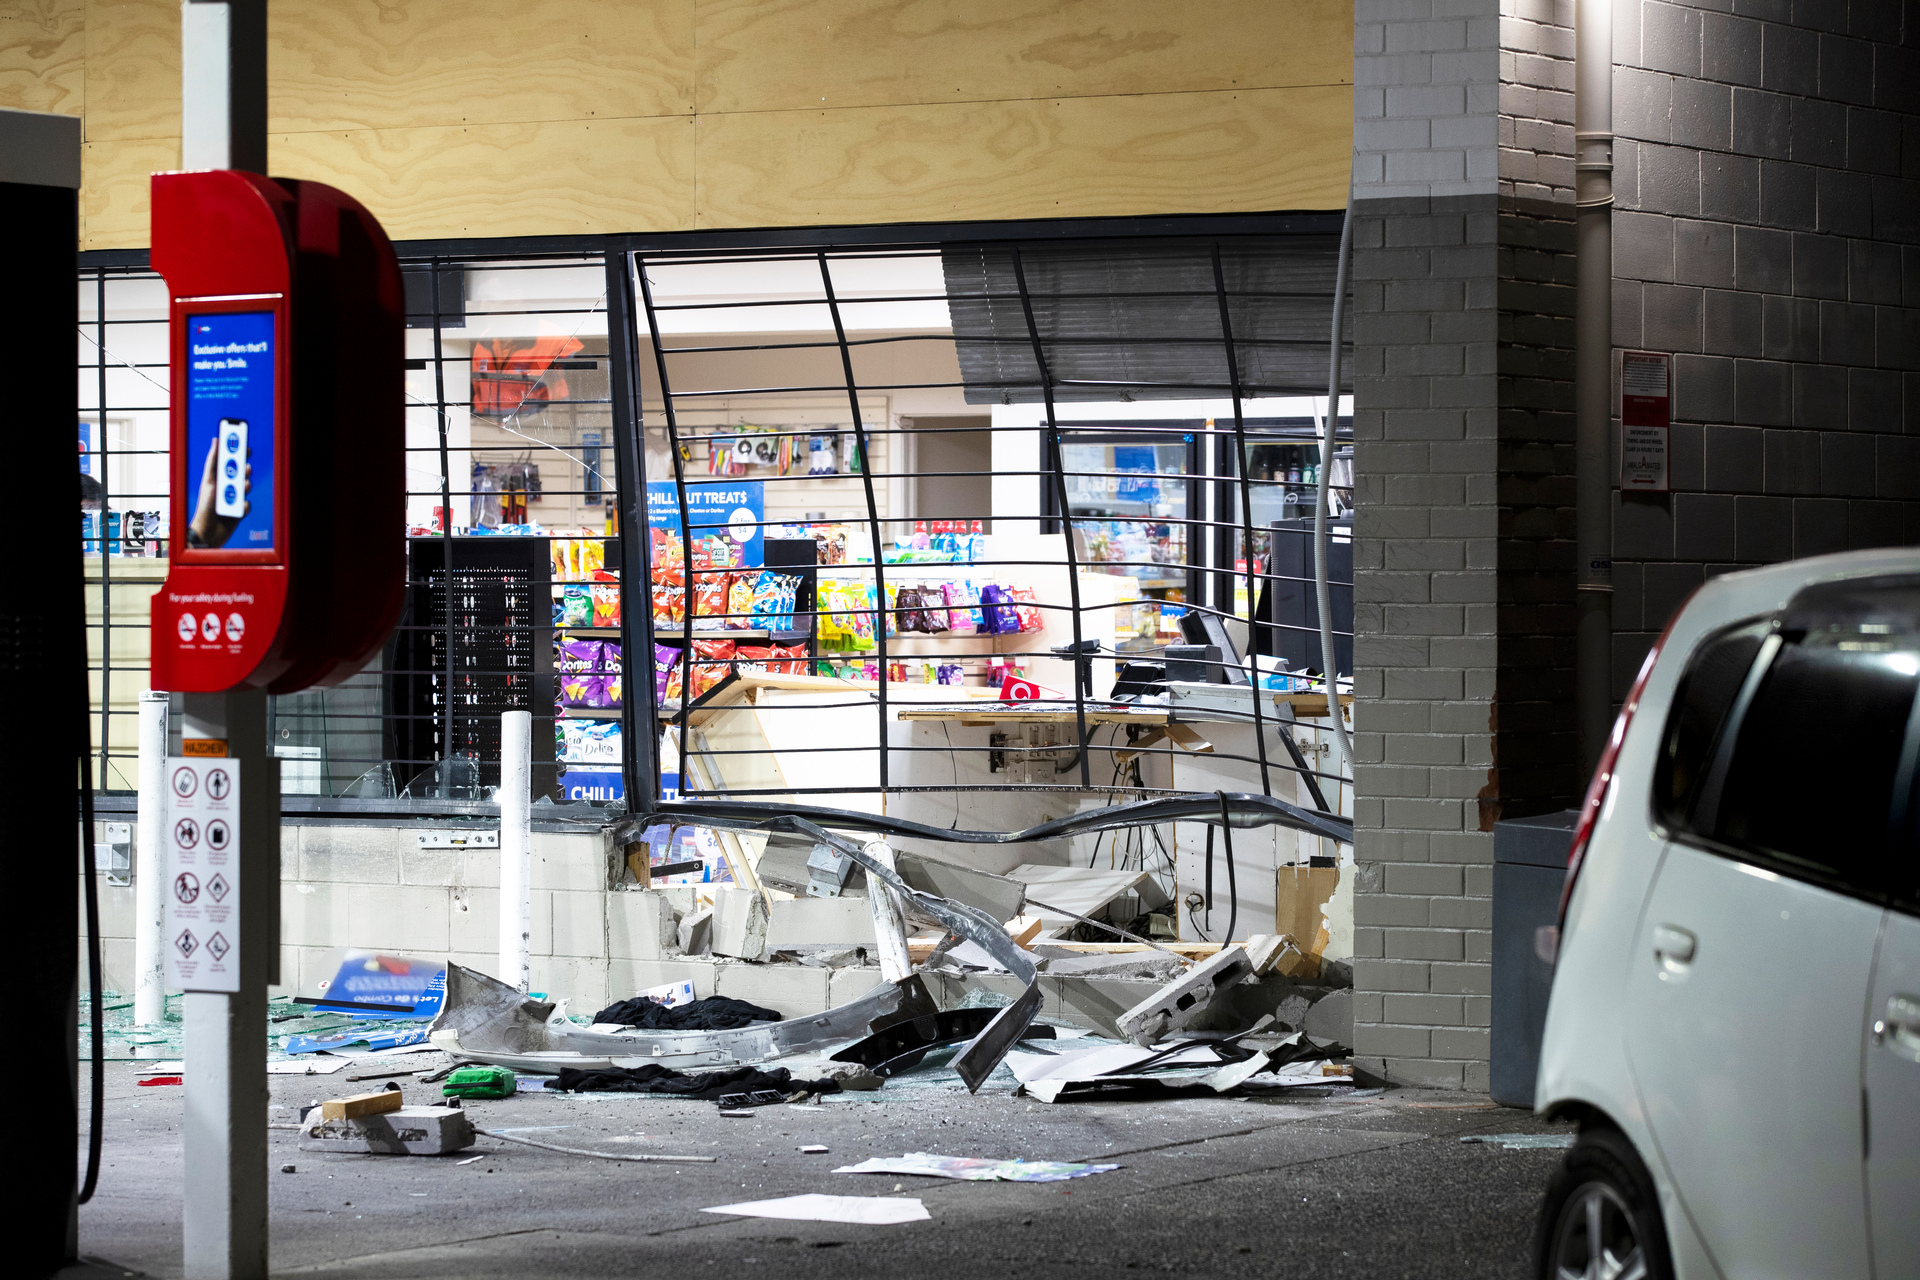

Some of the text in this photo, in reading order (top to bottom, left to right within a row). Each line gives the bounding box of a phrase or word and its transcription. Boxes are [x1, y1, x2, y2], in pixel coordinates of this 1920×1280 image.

[703, 490, 747, 505] TREAT$
[738, 526, 747, 534] $4
[562, 660, 593, 671] Doritos
[570, 786, 615, 801] CHILL
